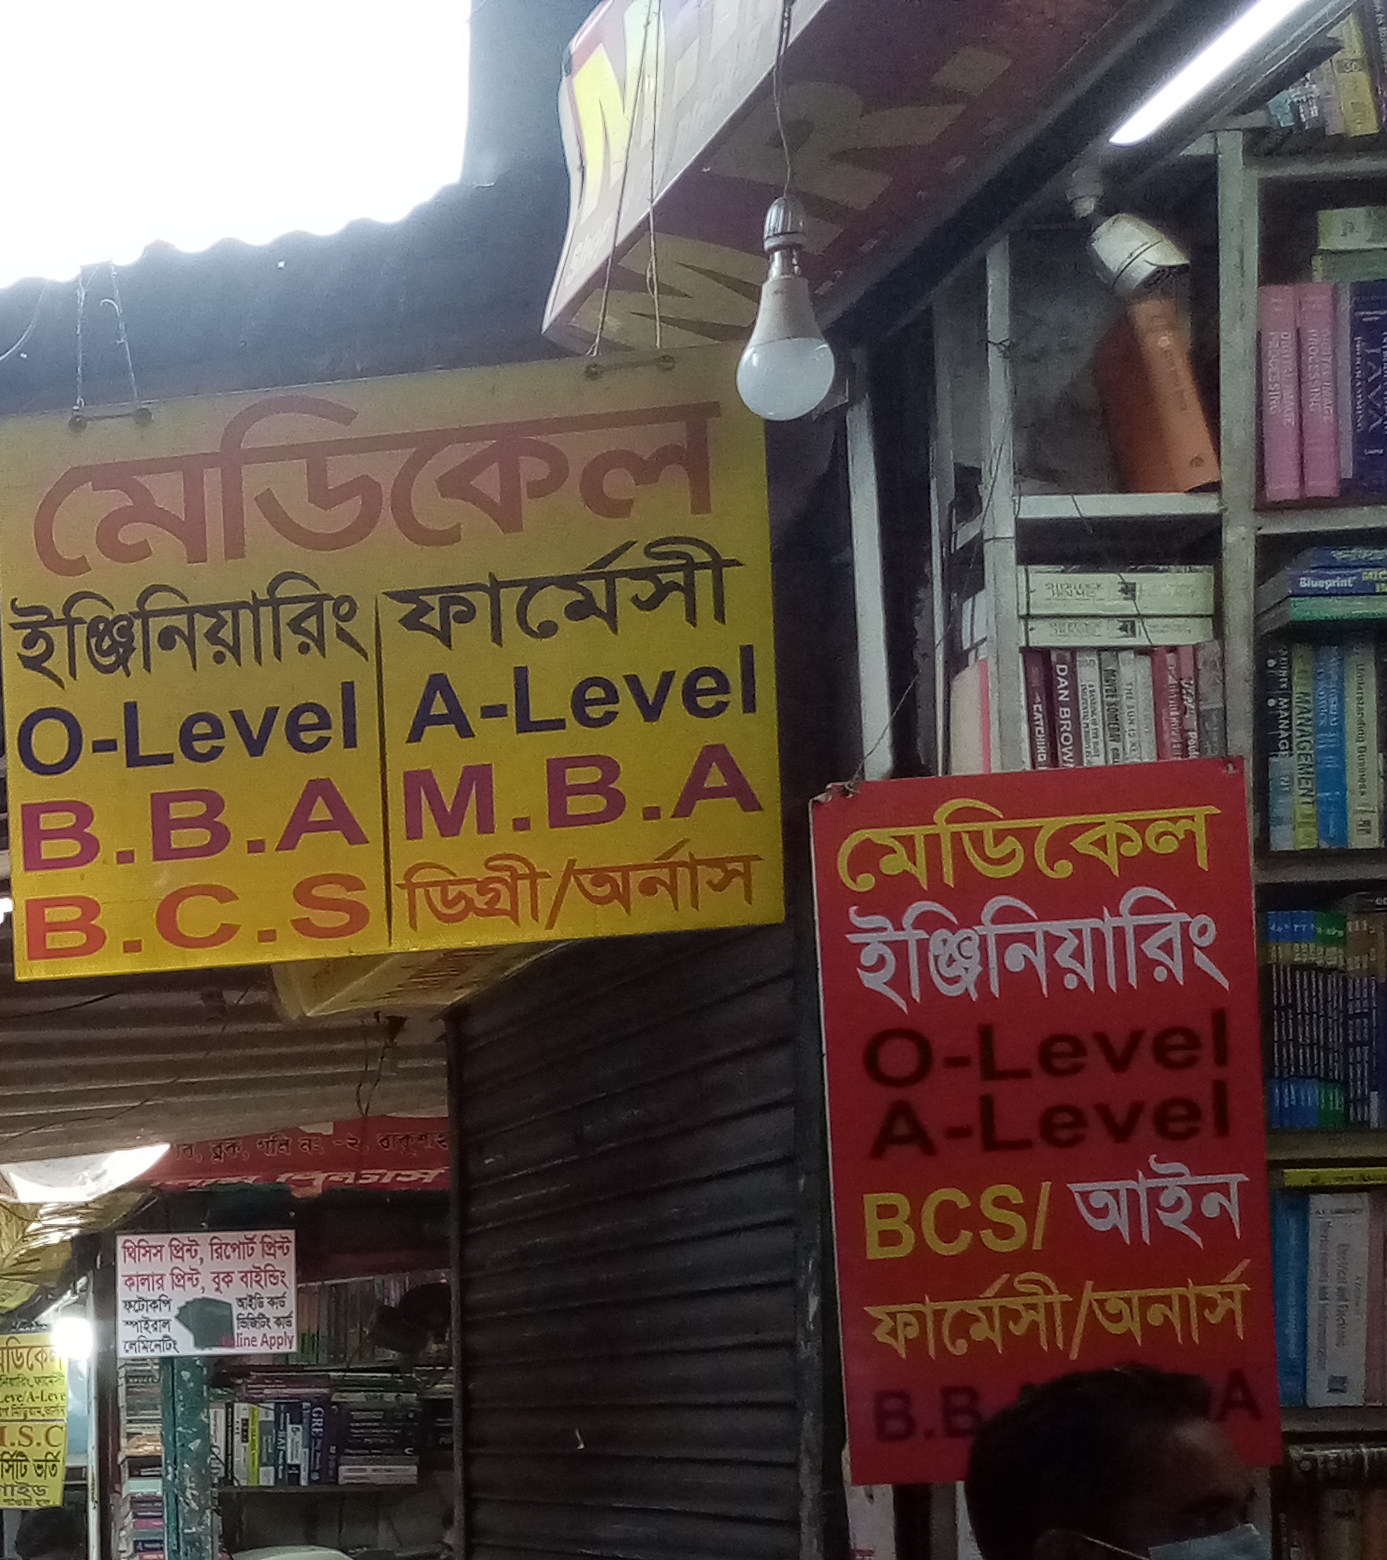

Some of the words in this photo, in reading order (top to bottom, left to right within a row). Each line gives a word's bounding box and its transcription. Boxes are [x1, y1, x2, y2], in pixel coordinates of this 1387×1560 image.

[32, 396, 722, 576] মেডিকেল
[11, 571, 369, 689] ইঞ্জিনিয়ারিং
[382, 535, 745, 650] ফার্মেসী
[17, 681, 358, 777] O-Level
[406, 645, 759, 745] A-Level
[1056, 664, 1071, 701] DAN
[20, 776, 370, 874] B.B.A
[403, 743, 764, 841] M.B.A
[837, 797, 1222, 892] মেডিকেল
[25, 873, 372, 962] B.C.S
[846, 886, 1230, 1015] ইঞ্জিনিয়ারিং
[862, 1007, 1230, 1089] O-Level
[869, 1079, 1230, 1161] A-Level
[862, 1180, 1052, 1261] BCS/
[1068, 1154, 1250, 1250] আইন
[122, 1239, 166, 1264] থিসিস
[122, 1271, 167, 1293] কালার
[210, 1269, 236, 1294] বুক
[260, 1332, 295, 1350] Apply
